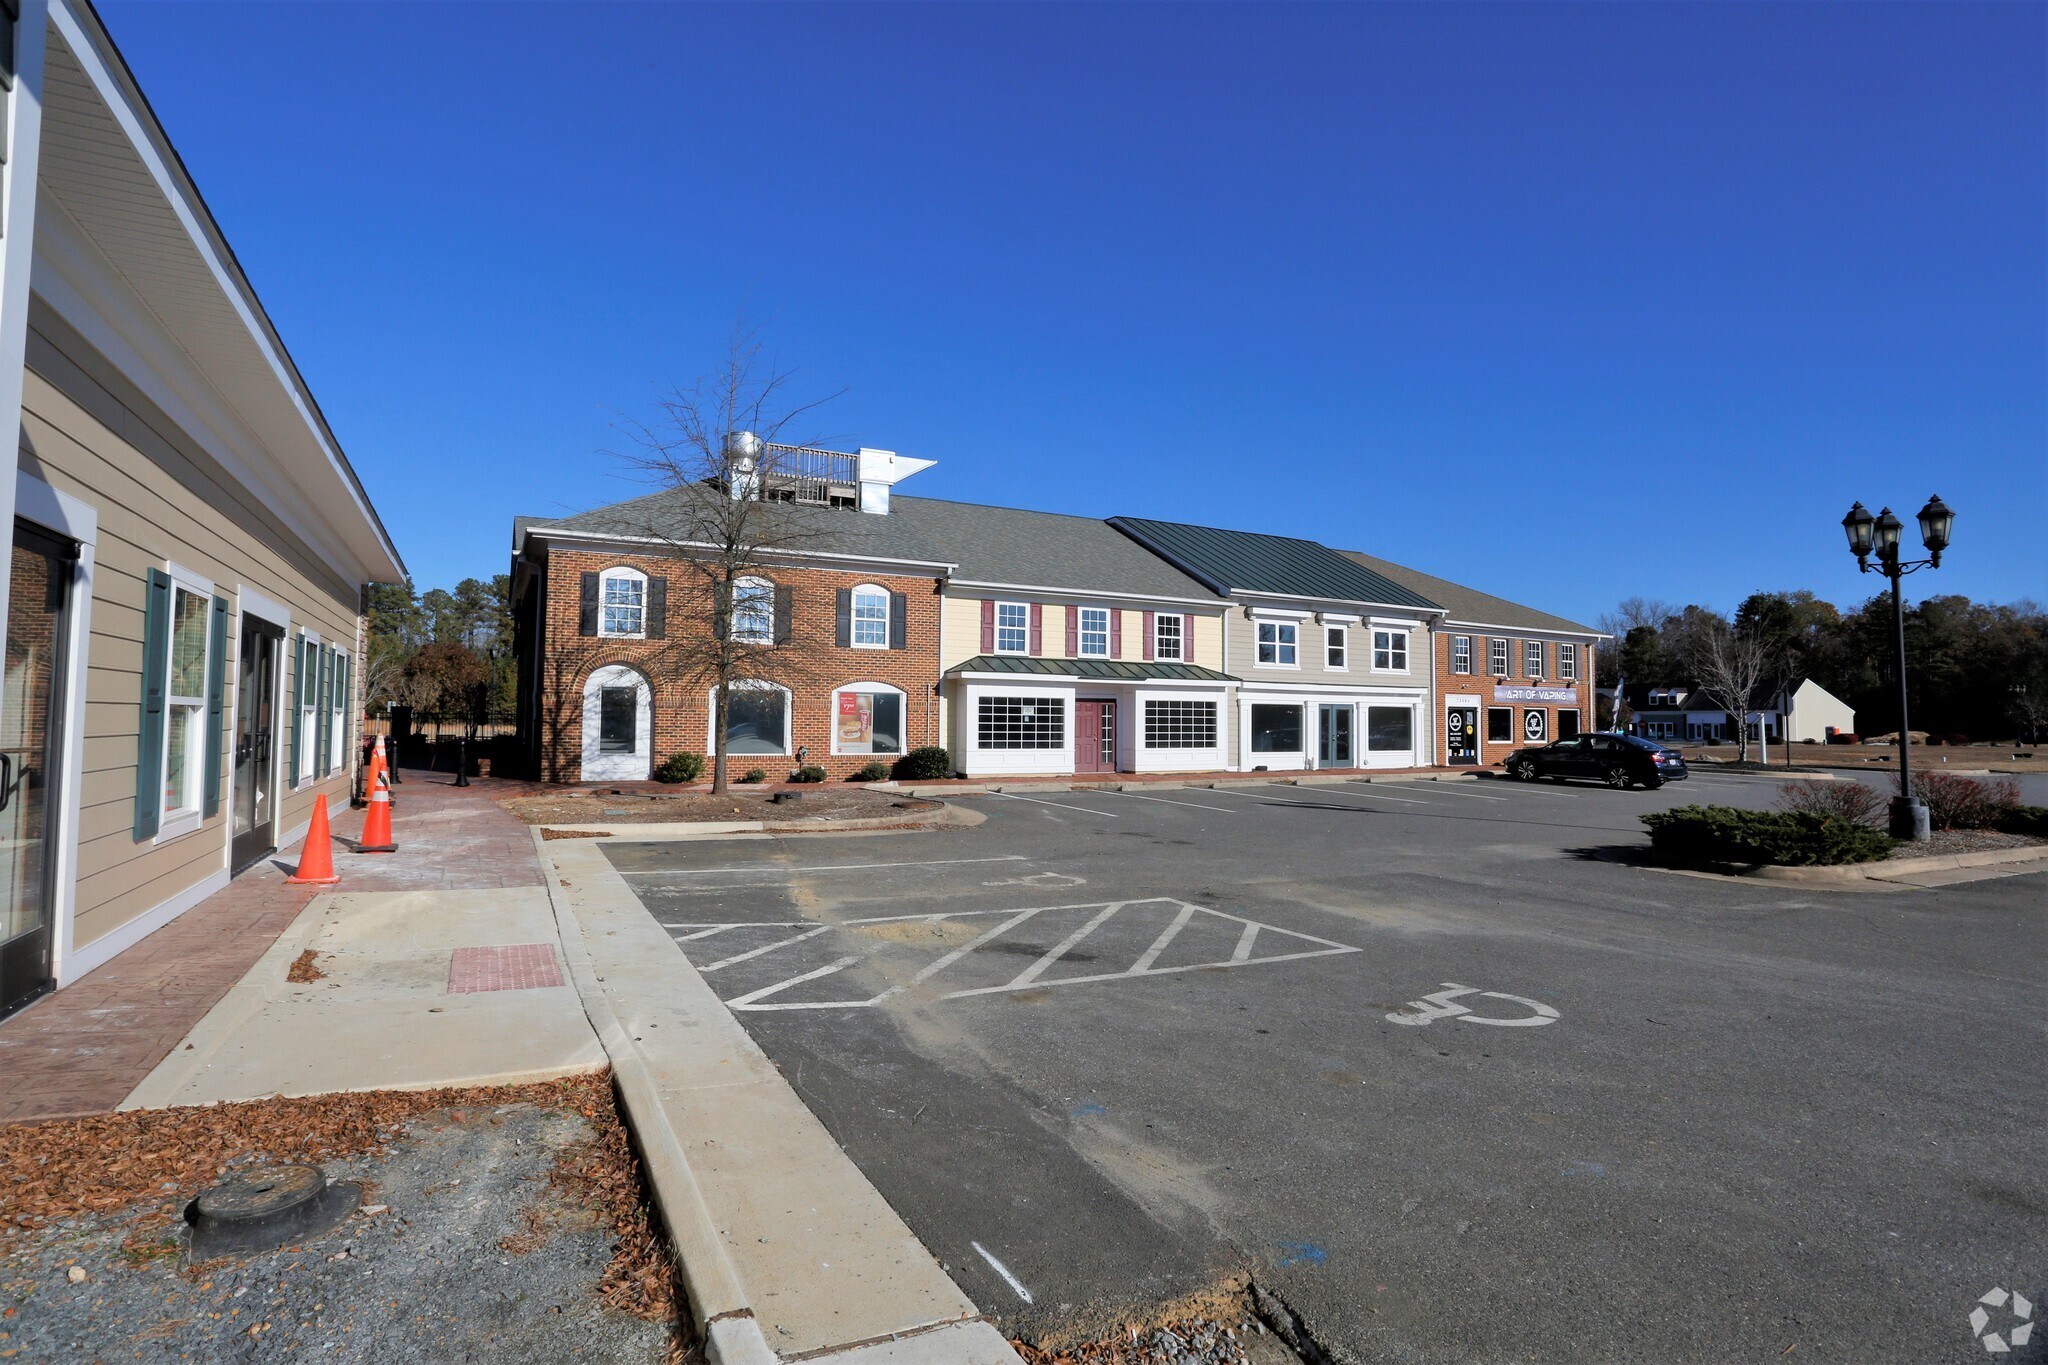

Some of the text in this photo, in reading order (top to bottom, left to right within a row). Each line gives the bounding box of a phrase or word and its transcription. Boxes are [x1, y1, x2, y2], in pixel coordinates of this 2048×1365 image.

[1506, 690, 1567, 700] ART OF VAPING
